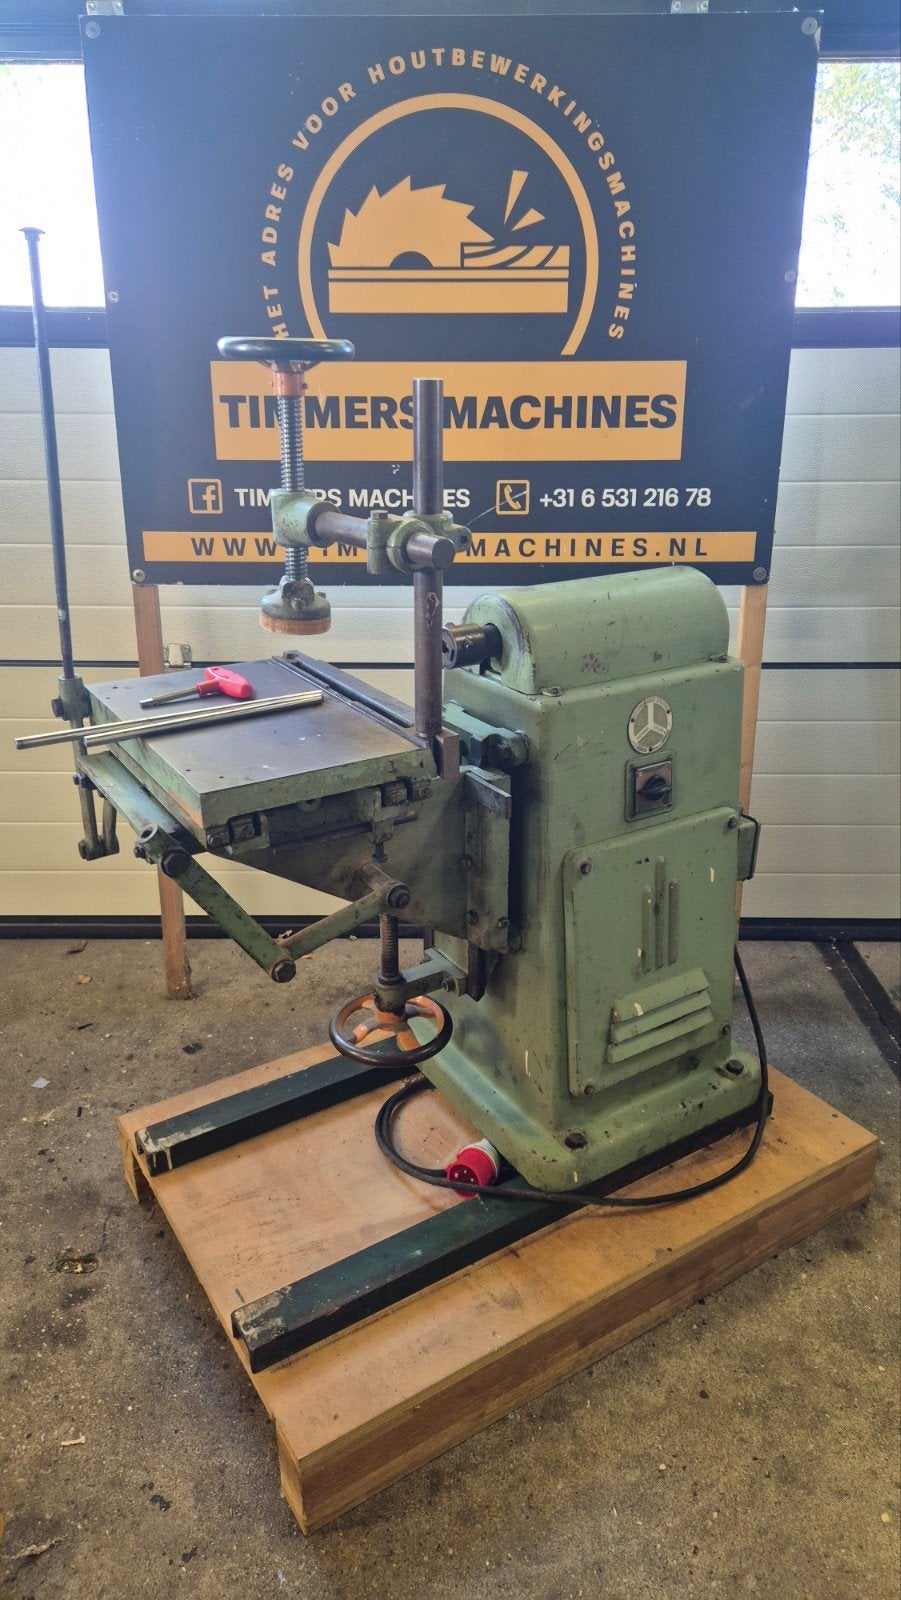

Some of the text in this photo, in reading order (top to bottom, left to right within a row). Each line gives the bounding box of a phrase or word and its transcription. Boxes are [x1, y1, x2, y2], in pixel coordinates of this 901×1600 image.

[260, 47, 636, 340] HET ADRES VOOR HOUTBEWERKINGSMACHINES
[349, 488, 471, 508] MACHES
[539, 487, 712, 508] +31 6 531 216 78
